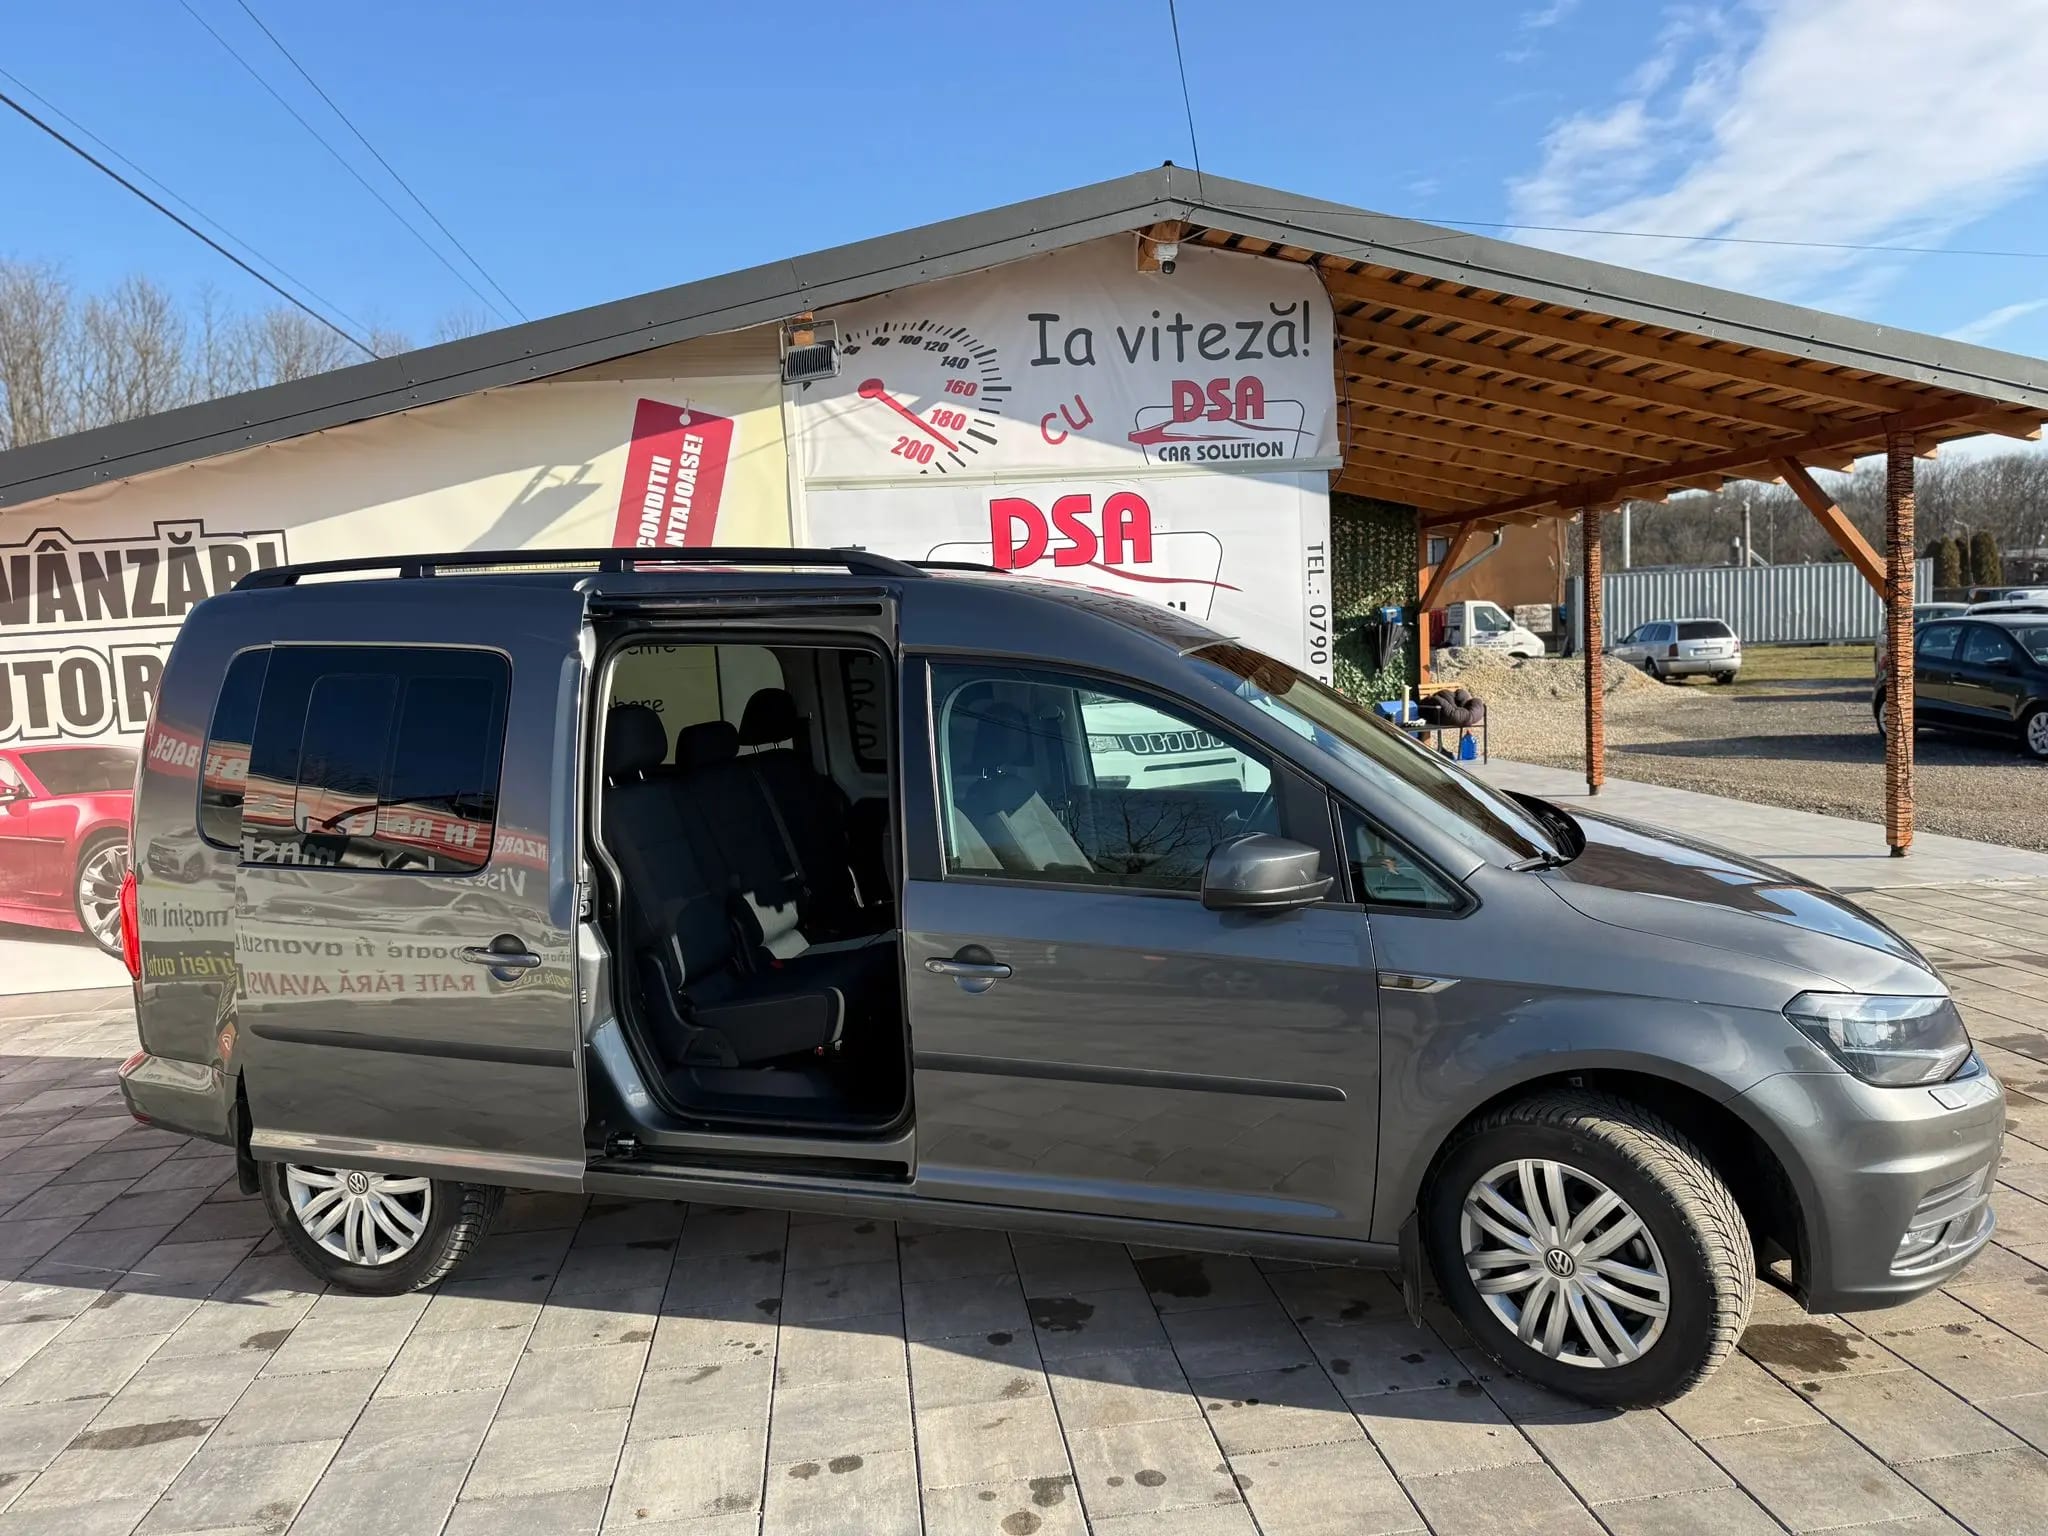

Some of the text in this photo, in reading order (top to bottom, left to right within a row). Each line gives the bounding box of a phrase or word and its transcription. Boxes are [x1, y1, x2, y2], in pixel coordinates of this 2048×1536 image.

[898, 335, 923, 346] 100
[1027, 299, 1311, 367] Ia viteză!
[923, 340, 950, 353] 120
[940, 355, 970, 370] 140
[944, 378, 978, 397] 160
[1171, 375, 1265, 423] DSA
[930, 408, 967, 431] 180
[1040, 393, 1094, 446] cu
[890, 436, 935, 465] 200
[1158, 441, 1284, 463] CAR SOLUTION
[989, 491, 1153, 570] DSA
[1308, 604, 1329, 666] 0790
